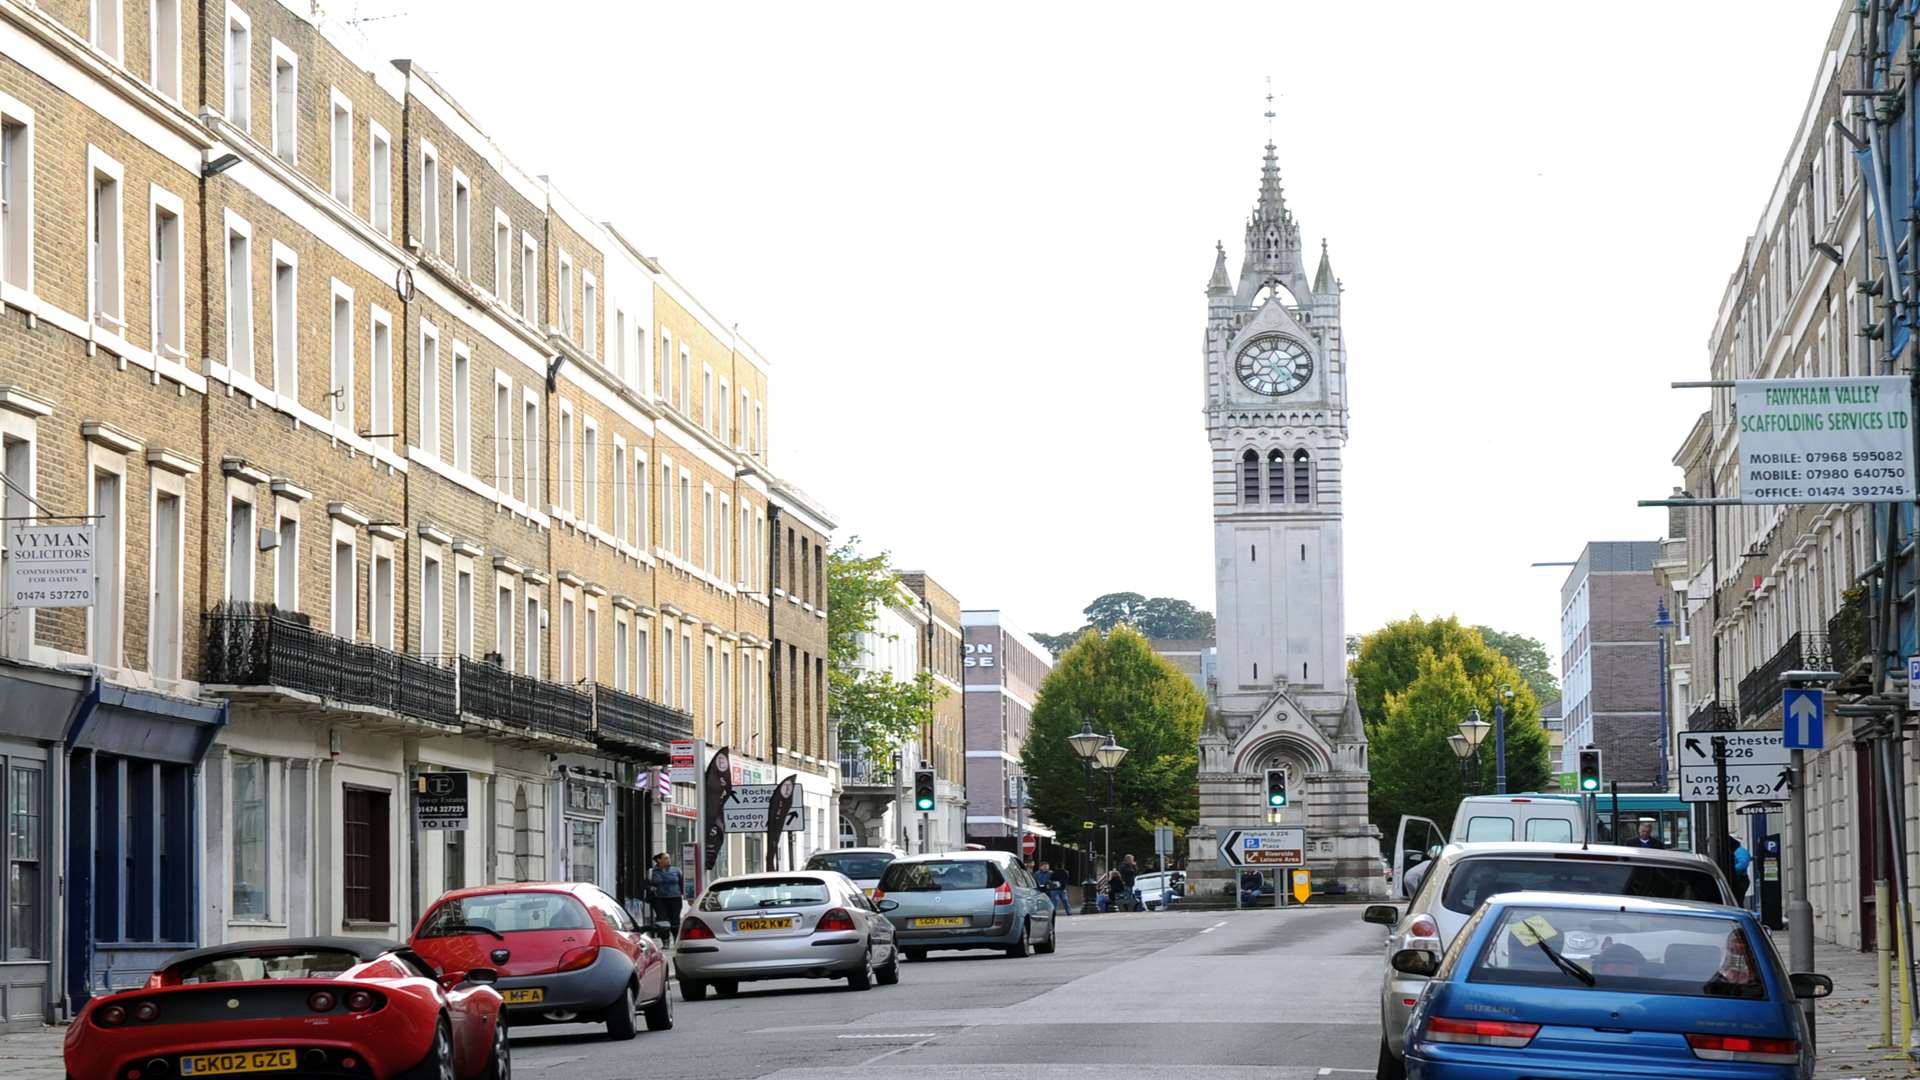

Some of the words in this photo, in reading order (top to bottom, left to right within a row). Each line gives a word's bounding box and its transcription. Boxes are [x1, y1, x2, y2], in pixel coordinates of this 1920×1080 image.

[1766, 386, 1831, 406] FAWKHAM
[1835, 385, 1880, 404] VALLEY
[1741, 413, 1824, 433] SCAFFOLDING
[1829, 412, 1883, 431] SERVICES
[1888, 411, 1908, 430] LTD
[1750, 453, 1802, 464] MOBILE:
[1806, 452, 1847, 463] 07968
[1852, 451, 1903, 462] 595082
[1750, 470, 1802, 481] MOBILE:
[1806, 469, 1849, 480] 07980
[1854, 468, 1905, 479] 640750
[1755, 487, 1802, 498] OFFICE:
[1807, 487, 1845, 497] 01474
[1852, 486, 1903, 496] 392745
[15, 550, 90, 560] SOLICITORS
[16, 568, 87, 576] COMMISSIONER
[17, 591, 45, 600] 01474
[50, 590, 89, 600] 537270
[727, 812, 764, 821] London
[422, 820, 438, 828] TO
[441, 820, 461, 828] LET
[194, 1055, 247, 1073] GK02
[252, 1052, 292, 1069] GZG
